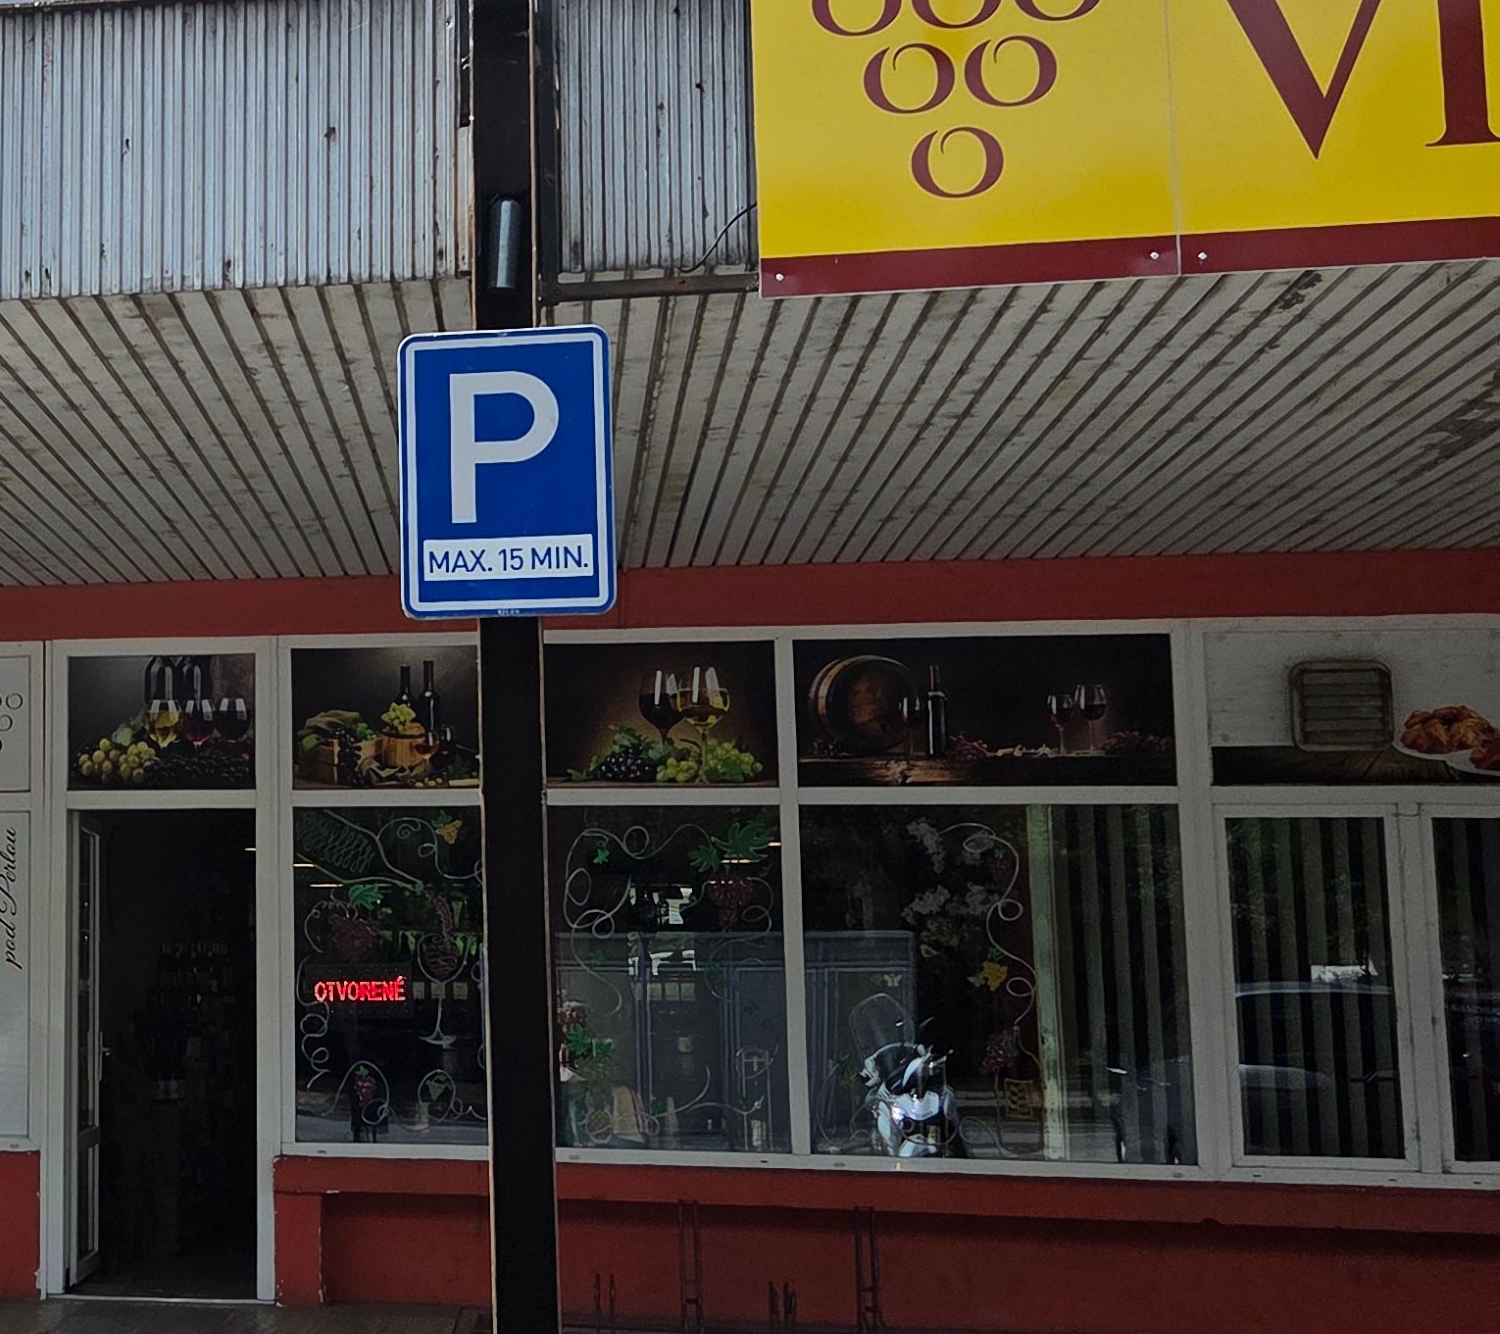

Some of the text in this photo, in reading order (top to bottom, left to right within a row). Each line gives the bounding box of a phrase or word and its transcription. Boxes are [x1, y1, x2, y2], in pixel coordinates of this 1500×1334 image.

[450, 370, 559, 524] P
[428, 545, 588, 573] MAX. 15 MIN.
[0, 918, 22, 969] pod
[314, 975, 406, 1002] OTVORENÉ
